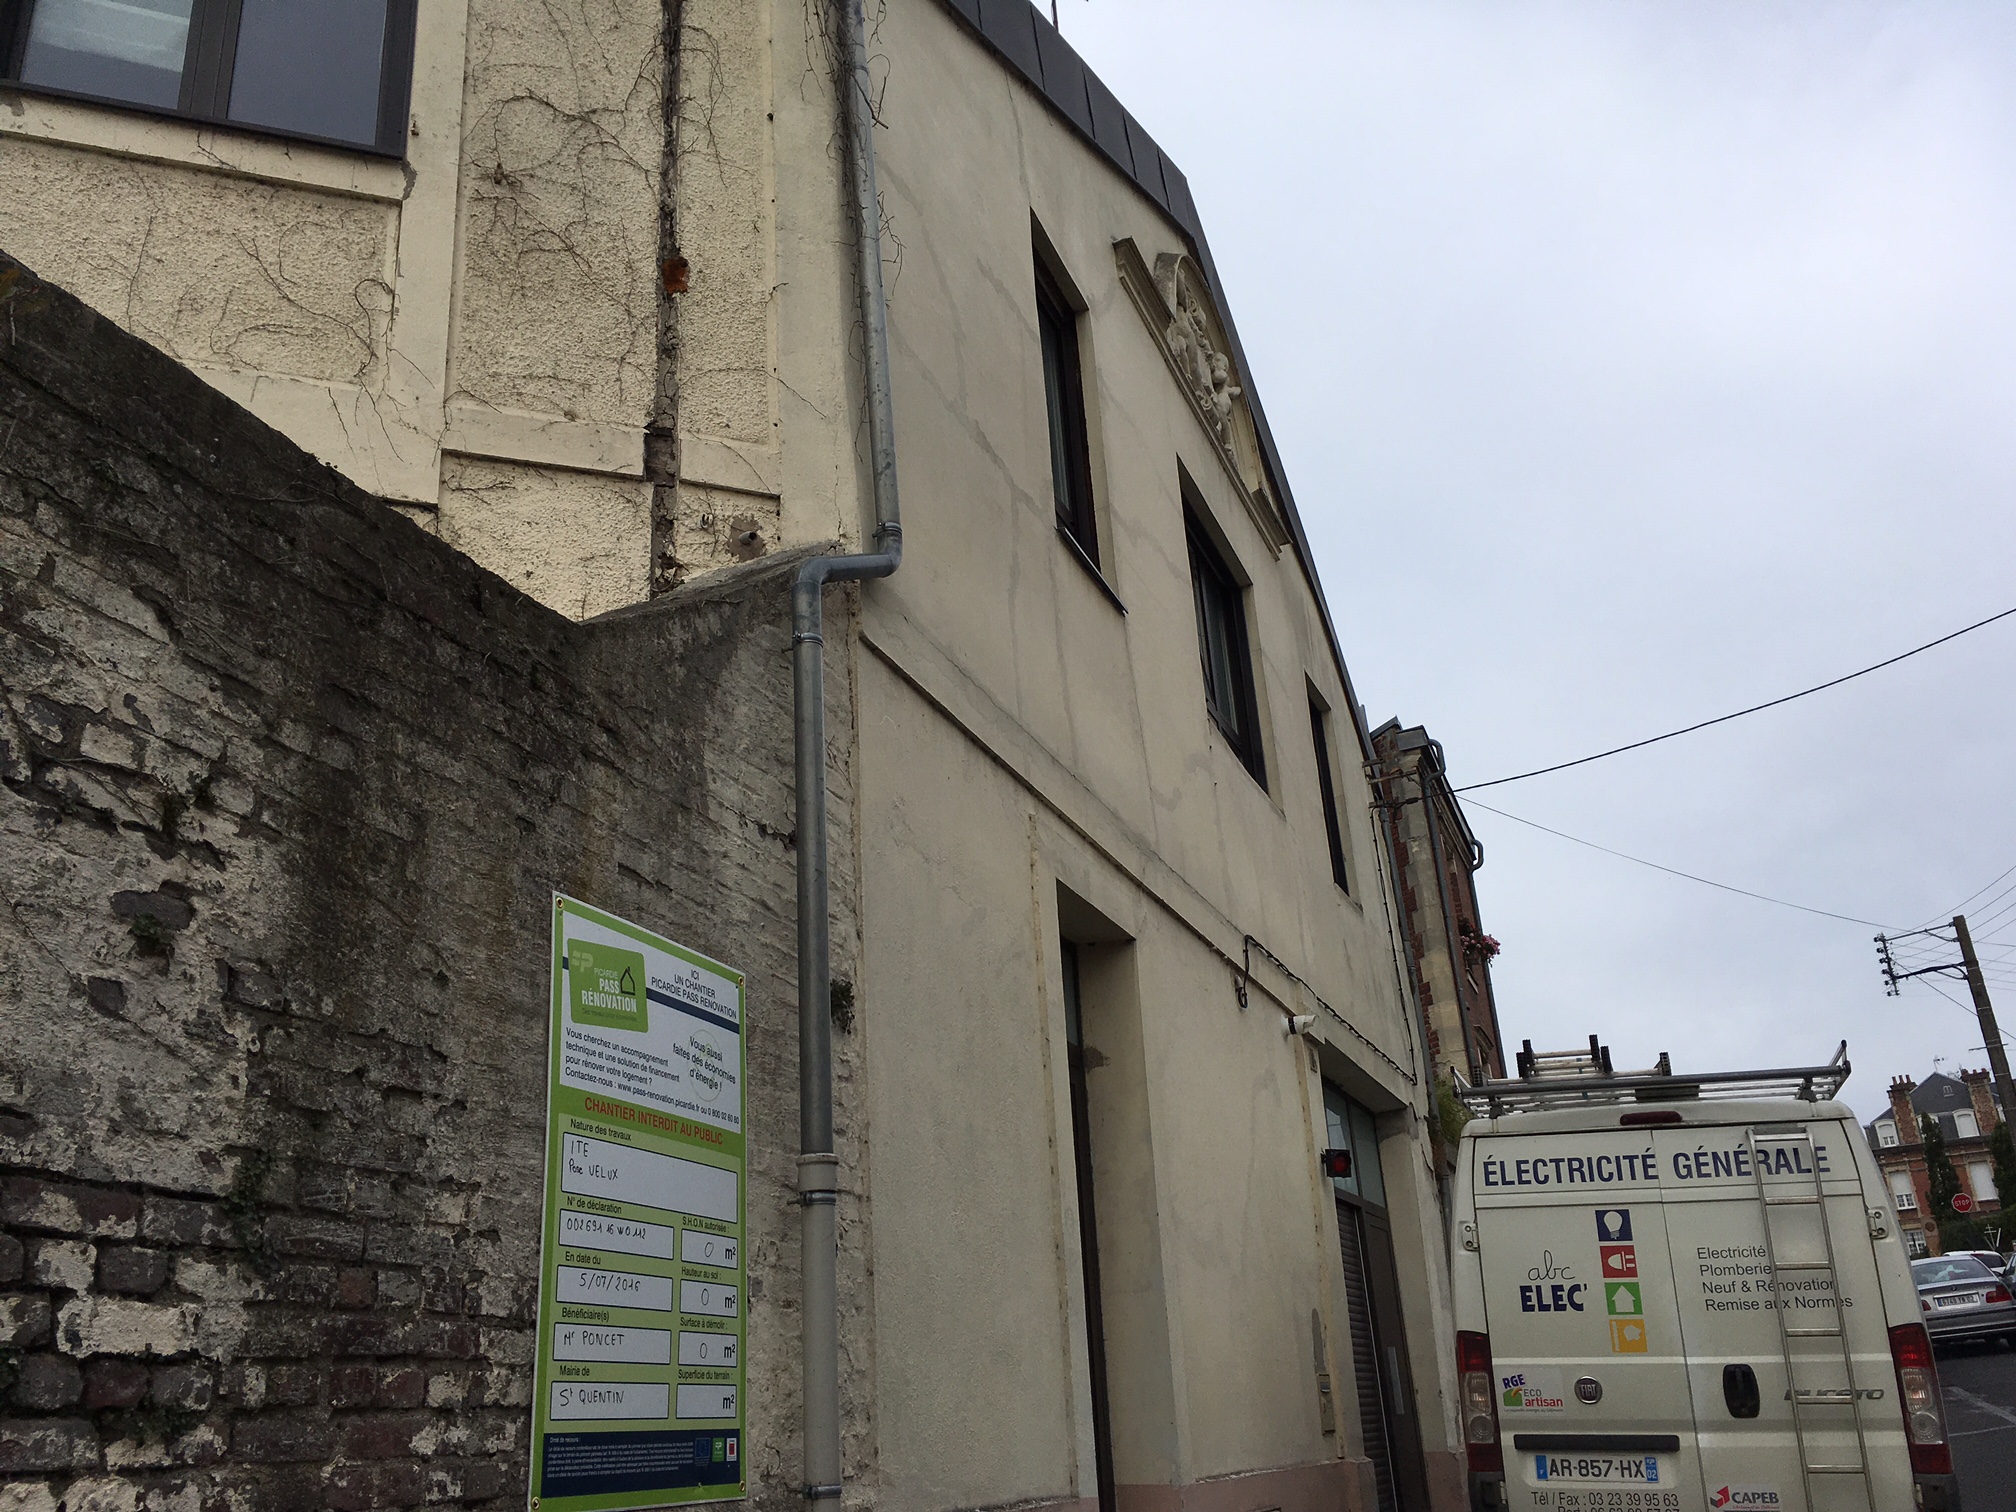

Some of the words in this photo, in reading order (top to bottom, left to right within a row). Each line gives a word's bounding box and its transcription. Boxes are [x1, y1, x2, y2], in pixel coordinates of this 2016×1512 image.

[594, 968, 618, 979] PICARDIE
[691, 969, 699, 980] ICI
[599, 978, 619, 994] PASS
[674, 974, 683, 985] UN
[685, 978, 715, 998] CHANTIER
[582, 988, 637, 1013] RÉNOVATION
[652, 977, 681, 996] PICARDIE
[683, 989, 699, 1003] PASS
[700, 997, 736, 1019] RENOVATION
[566, 1027, 582, 1040] Vous
[584, 1034, 611, 1048] cherchez
[612, 1043, 620, 1051] un
[621, 1046, 668, 1067] accompagnement
[690, 1036, 705, 1053] Vous
[707, 1047, 723, 1062] aussi
[566, 1041, 596, 1057] technique
[598, 1051, 604, 1059] et
[605, 1054, 616, 1062] une
[617, 1056, 639, 1070] solution
[641, 1063, 647, 1072] de
[648, 1065, 680, 1082] financement
[566, 1055, 581, 1064] pour
[582, 1058, 605, 1071] rénover
[606, 1066, 620, 1077] votre
[622, 1070, 648, 1084] logement
[673, 1043, 690, 1060] faites
[692, 1053, 704, 1067] des
[705, 1059, 736, 1084] économies
[690, 1067, 719, 1090] d'énergie
[565, 1067, 613, 1088] Contactez-nous
[618, 1083, 700, 1111] www.pass-renovation.picardie.fr
[701, 1106, 707, 1114] ou
[712, 1109, 720, 1118] 800
[585, 1097, 636, 1122] CHANTIER
[638, 1111, 679, 1133] INTERDIT
[680, 1122, 692, 1137] AU
[694, 1125, 723, 1146] PUBLIC
[570, 1118, 594, 1133] Nature
[596, 1123, 607, 1135] des
[608, 1126, 632, 1142] travaux
[1483, 1147, 1660, 1187] ÉLECTRICITÉ
[1672, 1144, 1831, 1180] GÉNÉRALE
[577, 1198, 586, 1208] de
[587, 1199, 622, 1214] déclaration
[704, 1221, 727, 1233] autorisée
[565, 1251, 575, 1262] En
[576, 1253, 591, 1264] date
[592, 1254, 601, 1265] du
[1697, 1245, 1766, 1260] Electricité
[681, 1266, 703, 1277] Hauteur
[704, 1270, 710, 1278] au
[1528, 1250, 1575, 1281] abc
[1699, 1263, 1772, 1276] Plomberie
[579, 1272, 641, 1292] 5/07/2016
[1702, 1280, 1736, 1294] Neuf
[1741, 1280, 1752, 1293] &
[1705, 1298, 1760, 1311] Remise
[562, 1306, 610, 1322] Bénéficiaire(s)
[680, 1317, 701, 1328] Surface
[701, 1319, 705, 1328] à
[706, 1319, 725, 1330] démolir
[582, 1330, 625, 1345] PONCET
[560, 1365, 580, 1376] Mairie
[581, 1366, 590, 1376] de
[678, 1368, 705, 1381] Superficie
[706, 1371, 713, 1379] du
[714, 1371, 730, 1380] terrain
[1502, 1374, 1525, 1389] RGE
[579, 1389, 624, 1405] QUENTIN
[1523, 1388, 1542, 1397] ECO
[1580, 1384, 1596, 1397] FIAT
[1525, 1397, 1563, 1407] artisan
[1549, 1458, 1645, 1478] AR-857-HX
[1647, 1469, 1657, 1479] 02
[1531, 1491, 1549, 1506] Tél
[1558, 1492, 1579, 1506] Fax
[1588, 1492, 1603, 1506] 03
[1607, 1492, 1623, 1506] 23
[1626, 1493, 1641, 1506] 39
[1644, 1493, 1660, 1507] 95
[1663, 1493, 1679, 1507] 63
[1731, 1492, 1779, 1504] CAPEB
